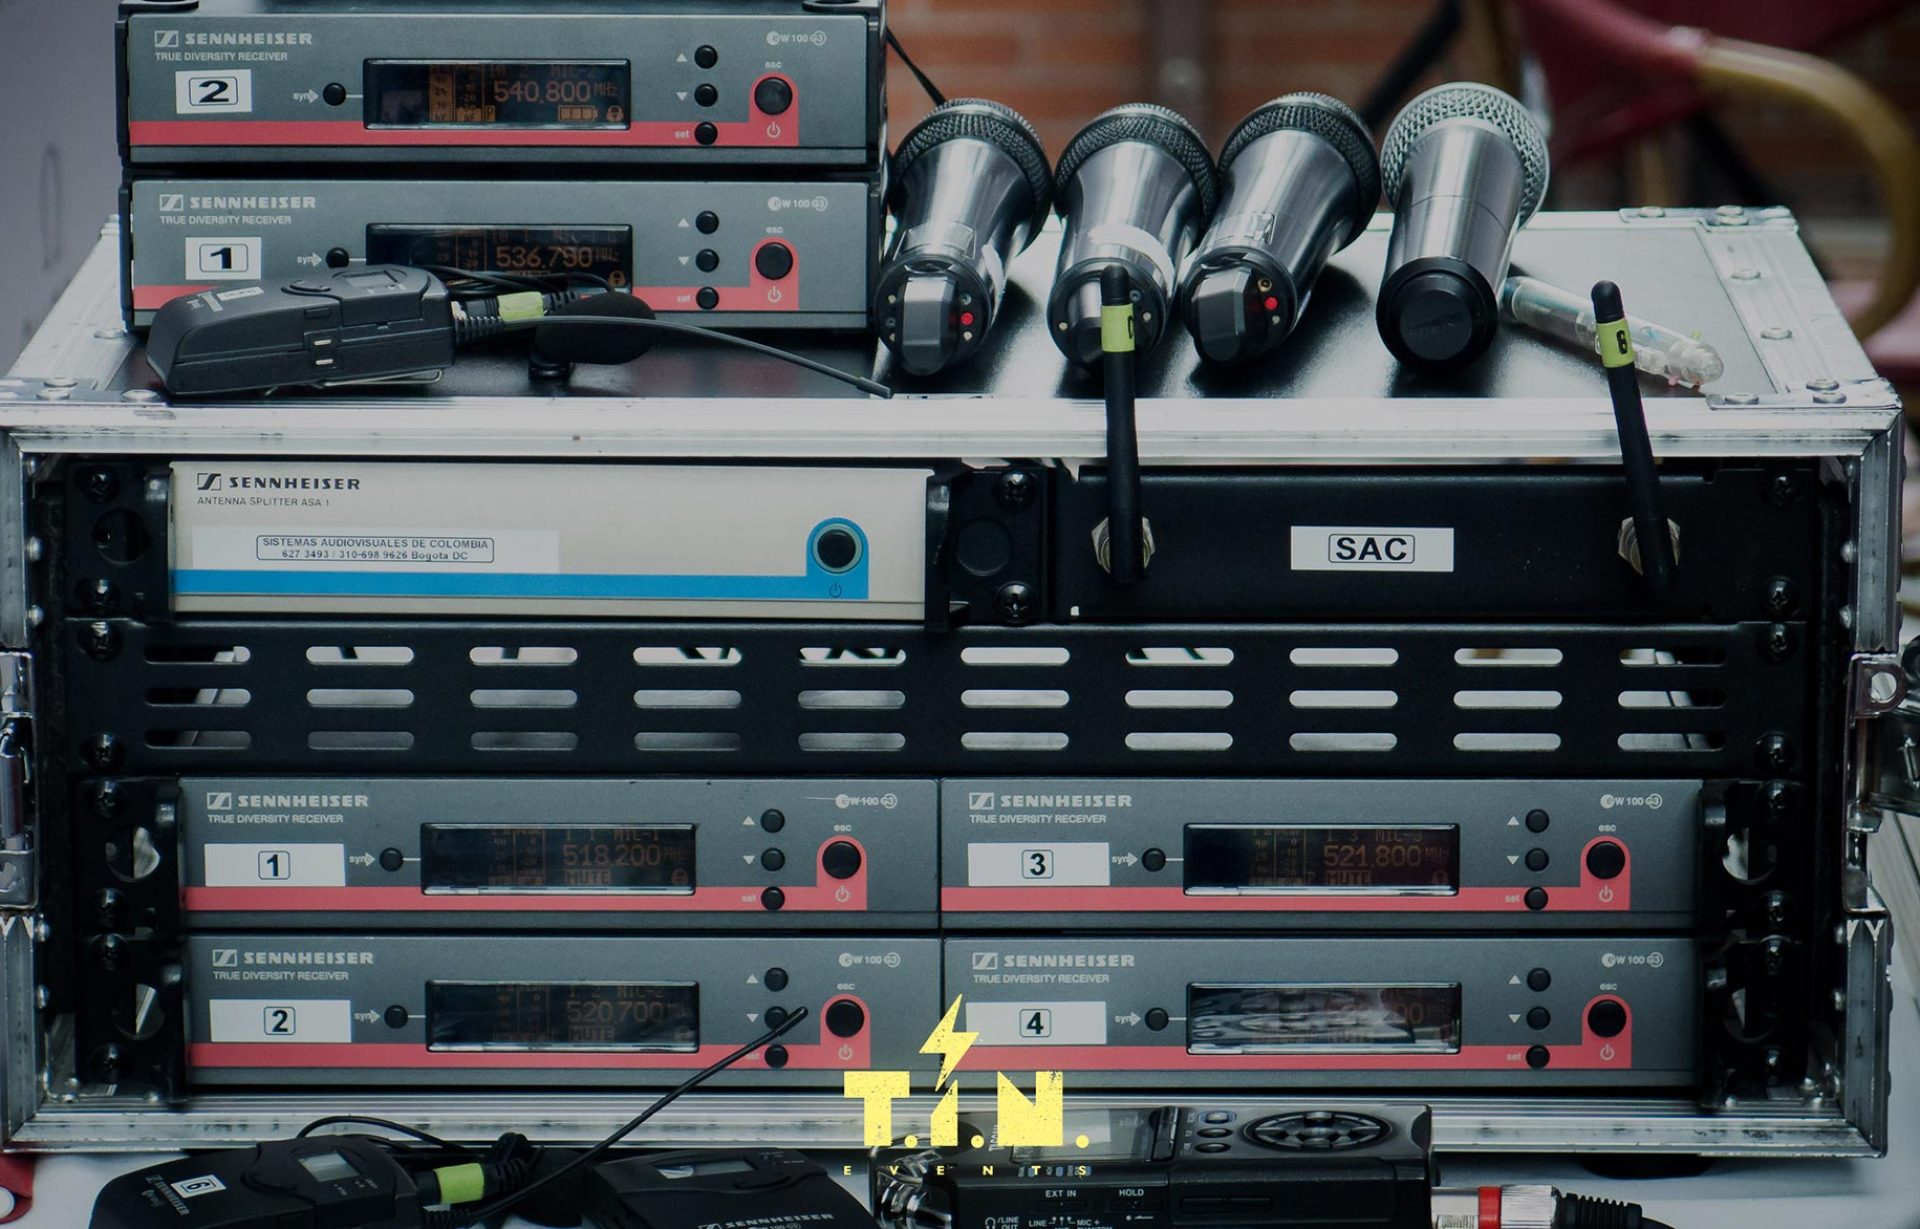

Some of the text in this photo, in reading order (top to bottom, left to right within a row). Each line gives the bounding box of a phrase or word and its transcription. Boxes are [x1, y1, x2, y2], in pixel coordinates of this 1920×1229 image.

[185, 33, 313, 45] SENNHEISER
[792, 34, 809, 43] 100
[155, 52, 288, 61] TRUE DIVERSITY RECEIVER
[199, 80, 229, 103] 2
[494, 80, 591, 103] 540.800
[190, 196, 317, 209] SENNHEISER
[793, 199, 810, 208] 100
[161, 215, 292, 225] TRUE DIVERSITY RECEIVER
[210, 247, 232, 269] 1
[229, 476, 360, 490] SENNHEISER
[197, 497, 330, 507] ANTENNA SPLITTER ASA 1
[262, 537, 490, 549] SISTEMAS AUDIOVISUALES DE COLOMBIA
[1335, 536, 1407, 561] SAC
[281, 549, 300, 559] 627
[304, 549, 329, 559] 3493
[339, 550, 380, 560] 310-698
[383, 550, 408, 560] 9626
[411, 551, 449, 562] Bogota
[452, 552, 469, 561] DC
[238, 794, 368, 808] SENNHEISER
[861, 797, 879, 806] 100
[1000, 794, 1132, 808] SENNHEISER
[1626, 796, 1644, 806] 100
[207, 814, 344, 824] TRUE DIVERSITY RECEIVER
[969, 814, 1107, 824] TRUE DIVERSITY RECEIVER
[562, 843, 661, 867] 518.200
[1323, 844, 1422, 867] 521.800
[265, 853, 280, 877] 1
[1029, 852, 1046, 876] 3
[243, 952, 374, 965] SENNHEISER
[865, 955, 882, 965] 100
[1003, 954, 1135, 968] SENNHEISER
[1627, 955, 1645, 965] 100
[213, 971, 349, 980] TRUE DIVERSITY RECEIVER
[973, 974, 1110, 983] TRUE DIVERSITY RECEIVER
[272, 1009, 289, 1032] 2
[1026, 1012, 1044, 1035] 4
[1045, 1189, 1077, 1198] EXT IN
[1118, 1188, 1145, 1197] HOLD
[725, 1213, 835, 1229] SENNHEISER
[1028, 1219, 1047, 1228] LINE
[1077, 1219, 1092, 1227] MIC
